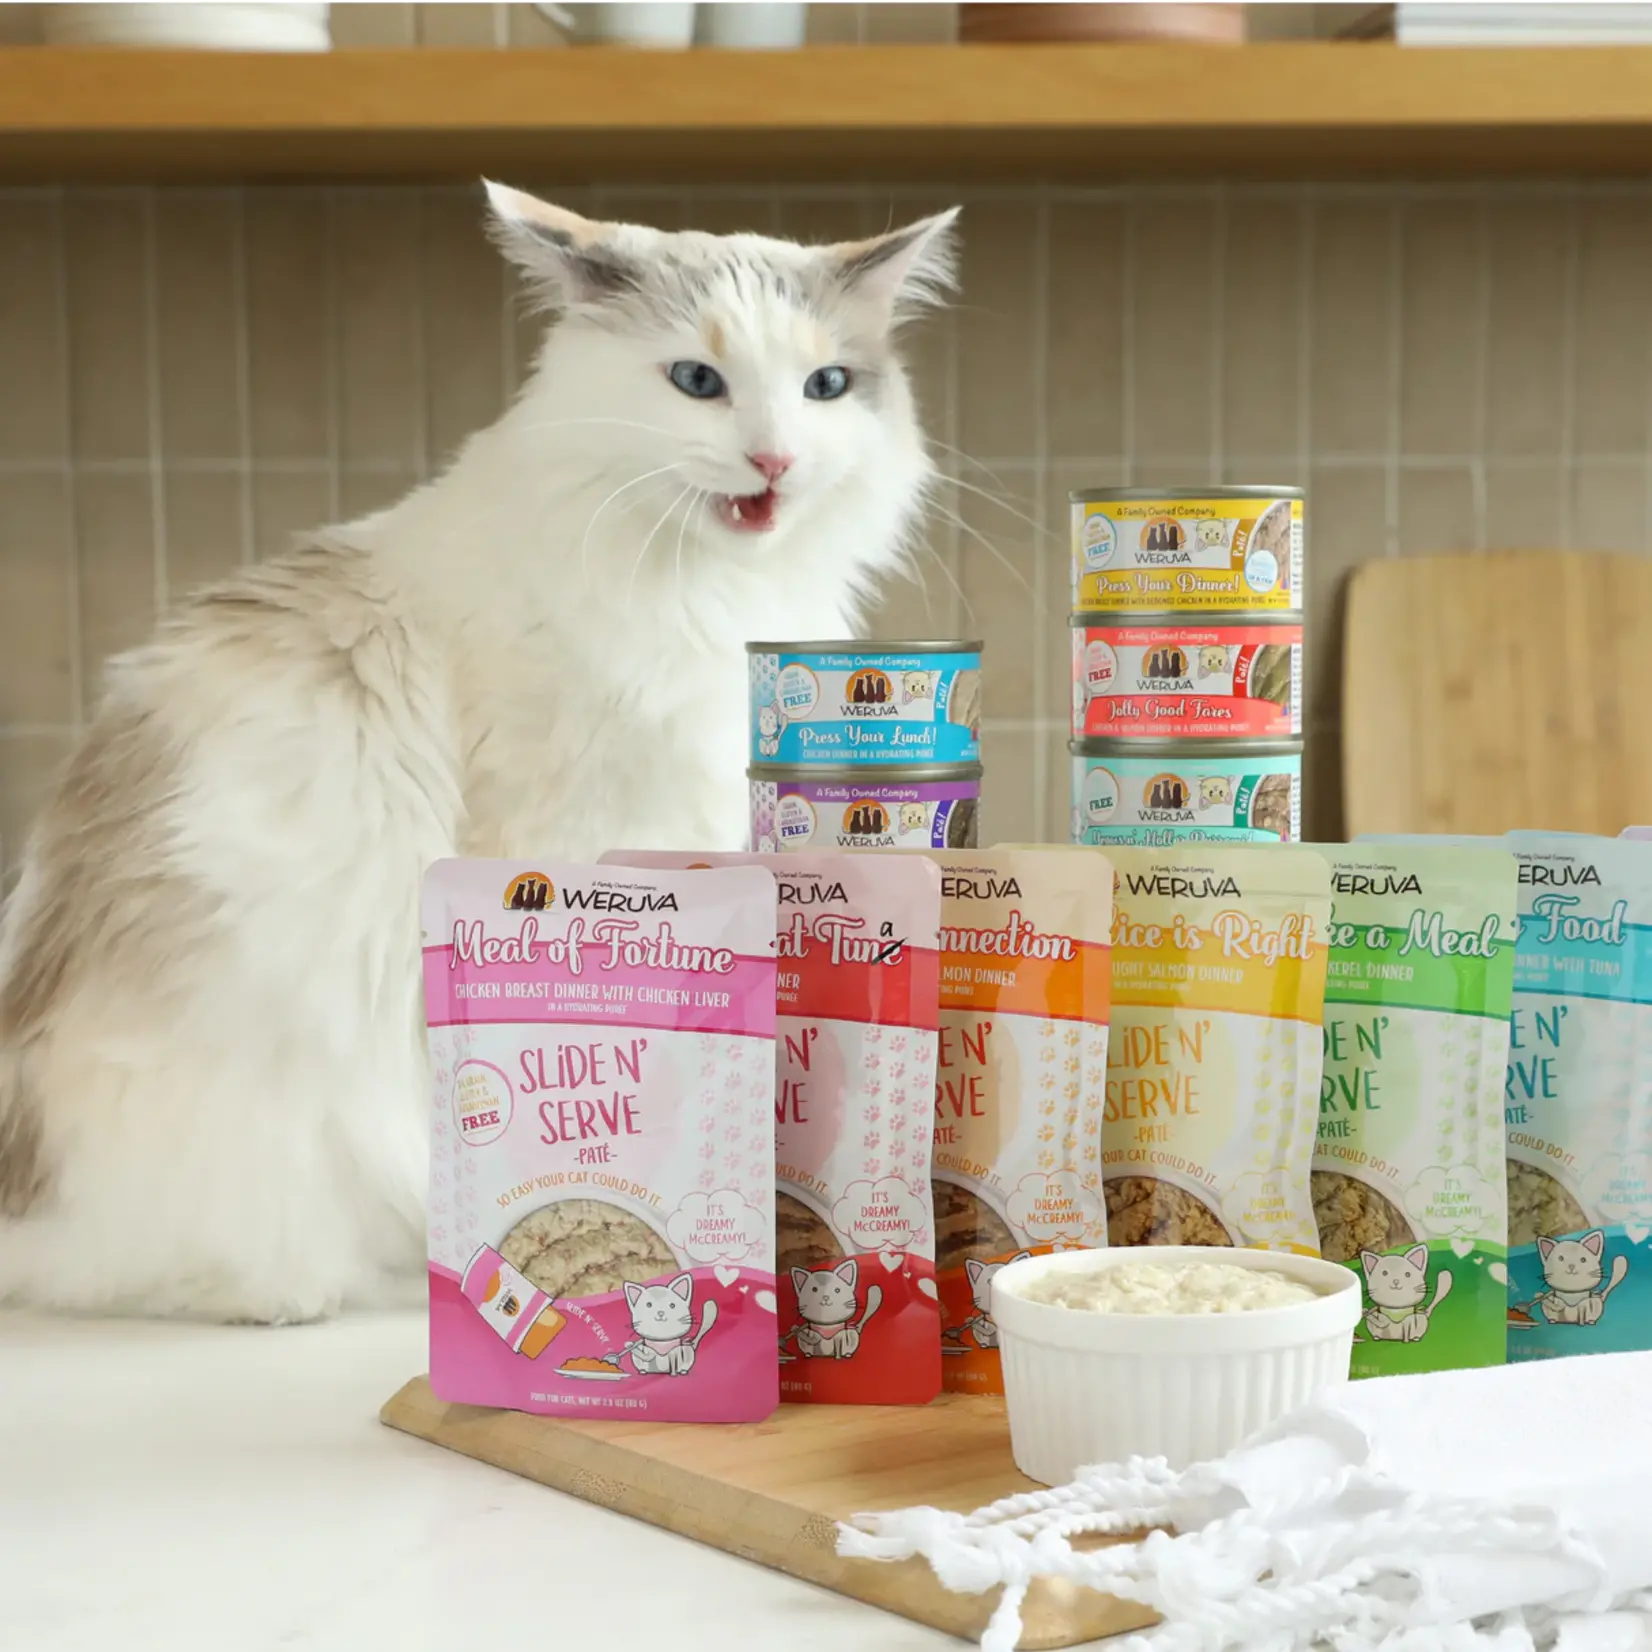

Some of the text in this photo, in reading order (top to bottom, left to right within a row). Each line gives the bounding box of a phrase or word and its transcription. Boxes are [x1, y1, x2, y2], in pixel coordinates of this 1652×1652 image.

[1124, 507, 1147, 517] Family
[1148, 507, 1176, 516] Owned
[1177, 507, 1216, 517] Company
[1134, 552, 1192, 564] WERUVA
[1096, 572, 1240, 595] Press Your Dinner!
[827, 656, 852, 668] Family
[855, 656, 884, 667] Owned
[885, 656, 920, 668] Company
[1088, 667, 1112, 682] FREE
[1136, 679, 1194, 691] WERUVA
[783, 692, 812, 709] FREE
[1108, 697, 1232, 721] Jolly Good Fares
[840, 705, 898, 718] WERUVA
[798, 725, 937, 747] Press Your Lunch!
[816, 788, 918, 800] A Family Owned Company
[1089, 796, 1113, 811] FREE
[1137, 810, 1195, 823] WERUVA
[781, 824, 810, 837] FREE
[836, 835, 895, 848] WERUVA
[1126, 873, 1241, 899] WERUVA
[562, 888, 679, 913] WERUVA
[1532, 893, 1629, 947] Food
[1172, 914, 1205, 951] is
[1210, 908, 1317, 967] Right
[1364, 924, 1392, 950] a
[1397, 908, 1500, 960] Meal
[449, 916, 736, 977] Meal of Fortune
[974, 968, 1016, 987] DINNER
[1199, 965, 1244, 983] DINNER
[1366, 962, 1414, 981] DINNER
[455, 982, 730, 1009] CHICKEN BREAST DINNER WITH CHICKEN LIVER
[1535, 1004, 1568, 1049] N'
[961, 1021, 992, 1066] N'
[1176, 1019, 1211, 1064] N'
[1356, 1016, 1390, 1061] N'
[785, 1027, 819, 1072] N'
[615, 1038, 648, 1085] N'
[1103, 1069, 1201, 1123] SERVE
[462, 1110, 500, 1132] FREE
[539, 1090, 642, 1146] SERVE
[1508, 1131, 1563, 1159] COULD DO
[936, 1153, 971, 1172] COULD
[973, 1164, 990, 1180] DO
[1128, 1149, 1147, 1162] CAT
[1149, 1150, 1185, 1171] COULD
[1186, 1163, 1204, 1180] DO
[1332, 1145, 1386, 1172] COULD DO
[798, 1170, 814, 1187] DO
[496, 1195, 511, 1210] SO
[509, 1181, 535, 1205] EASY
[535, 1173, 566, 1189] YOUR
[568, 1171, 588, 1184] CAT
[592, 1171, 629, 1193] COULD
[629, 1183, 648, 1200] DO
[871, 1191, 889, 1203] IT'S
[1045, 1184, 1063, 1196] IT'S
[706, 1203, 725, 1217] IT'S
[860, 1205, 900, 1218] DREAMY
[1034, 1197, 1074, 1211] DREAMY
[696, 1217, 736, 1232] DREAMY
[854, 1219, 910, 1232] McCREAMY!
[1027, 1211, 1084, 1225] McCREAMY!
[688, 1230, 747, 1245] McCREAMY!
